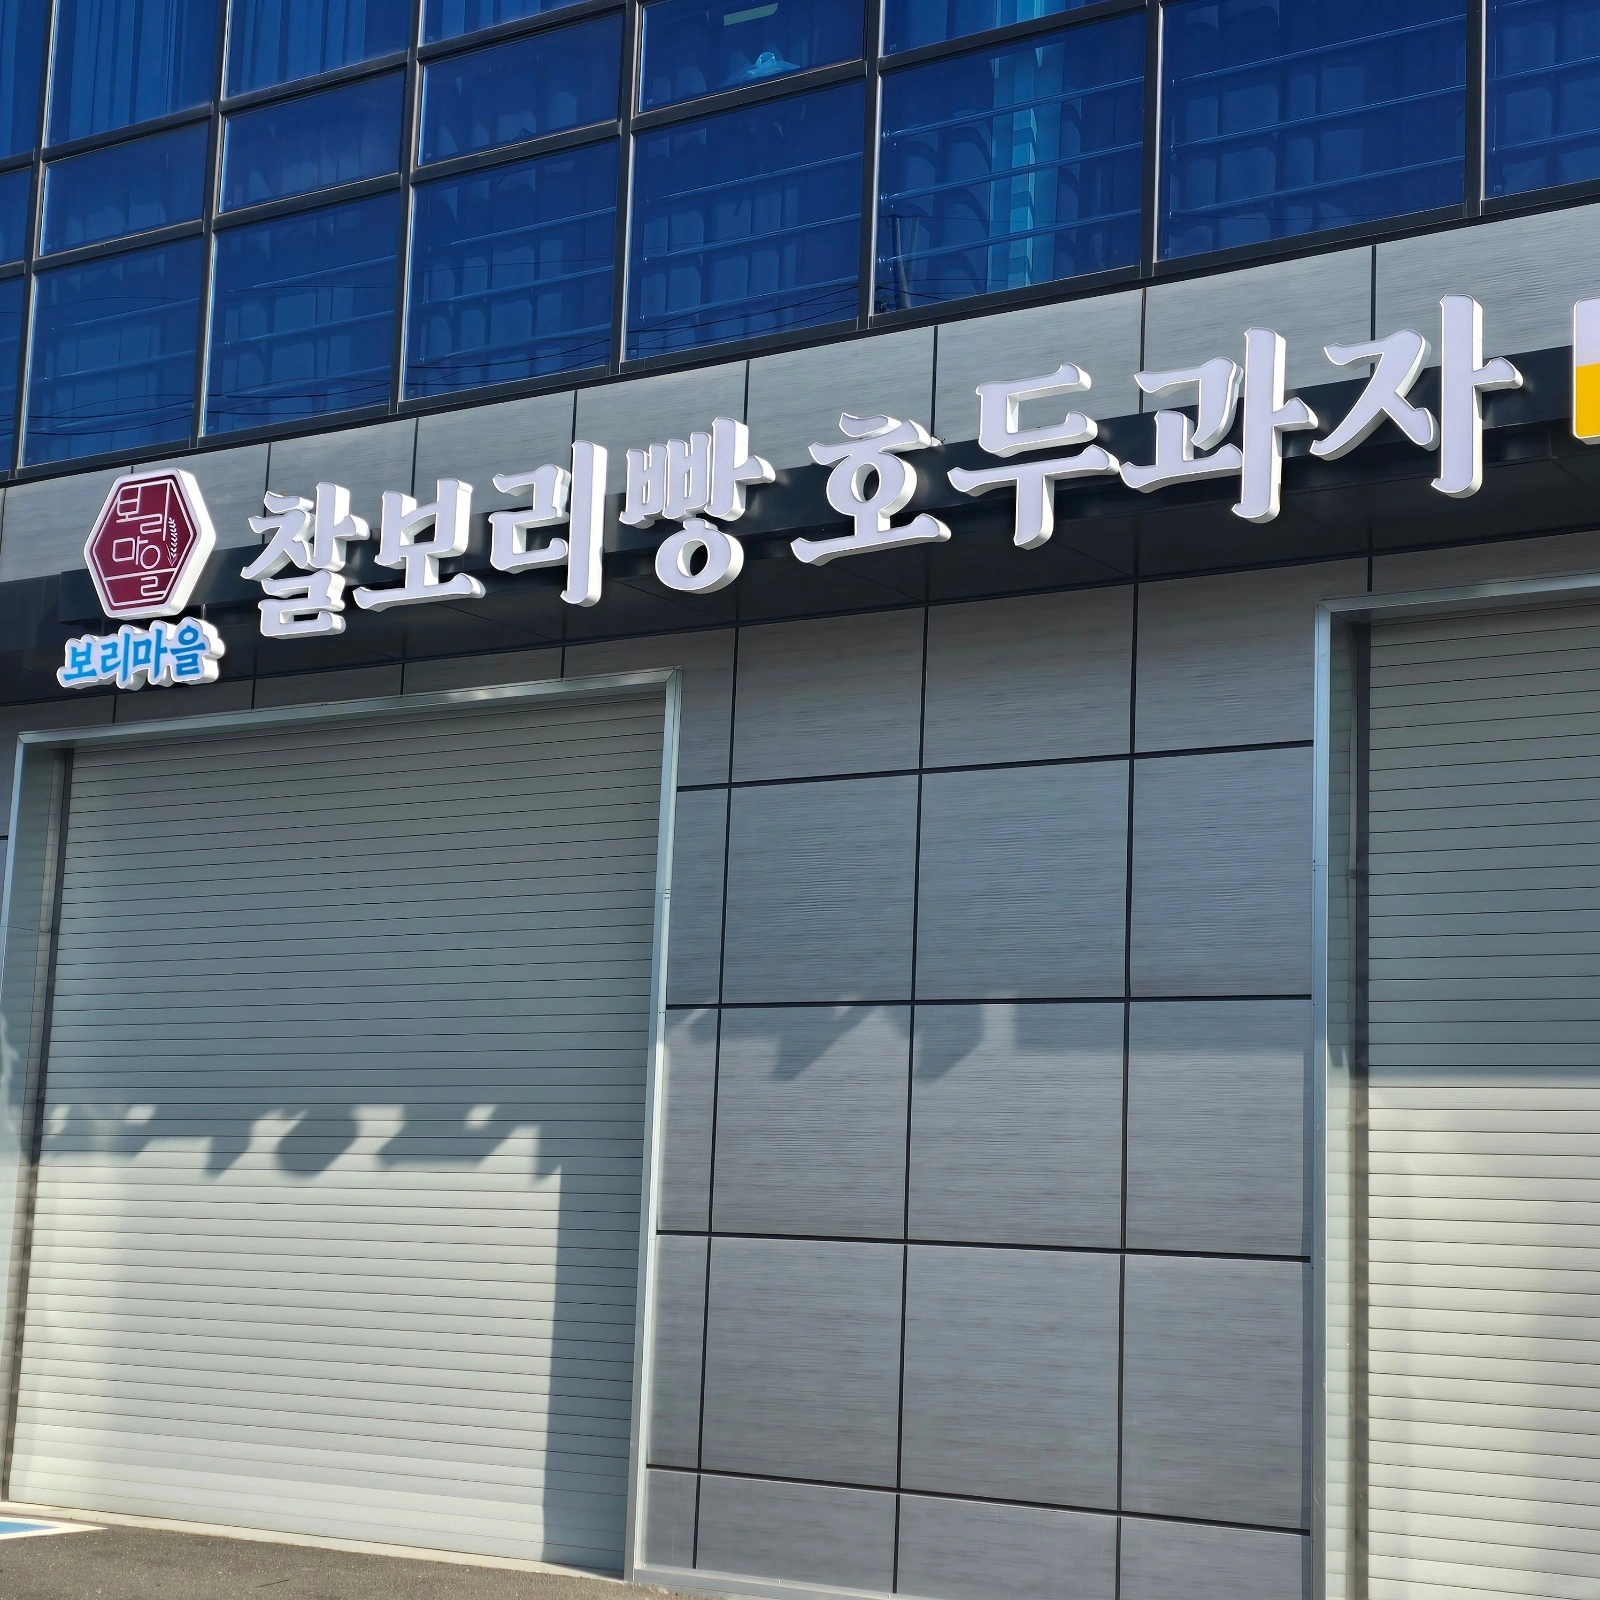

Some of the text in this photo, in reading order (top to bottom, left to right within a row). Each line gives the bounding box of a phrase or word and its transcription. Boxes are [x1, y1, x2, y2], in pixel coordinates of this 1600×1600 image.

[241, 294, 1524, 638] 찰보리빵 호두과자
[63, 625, 206, 683] 보리마을
